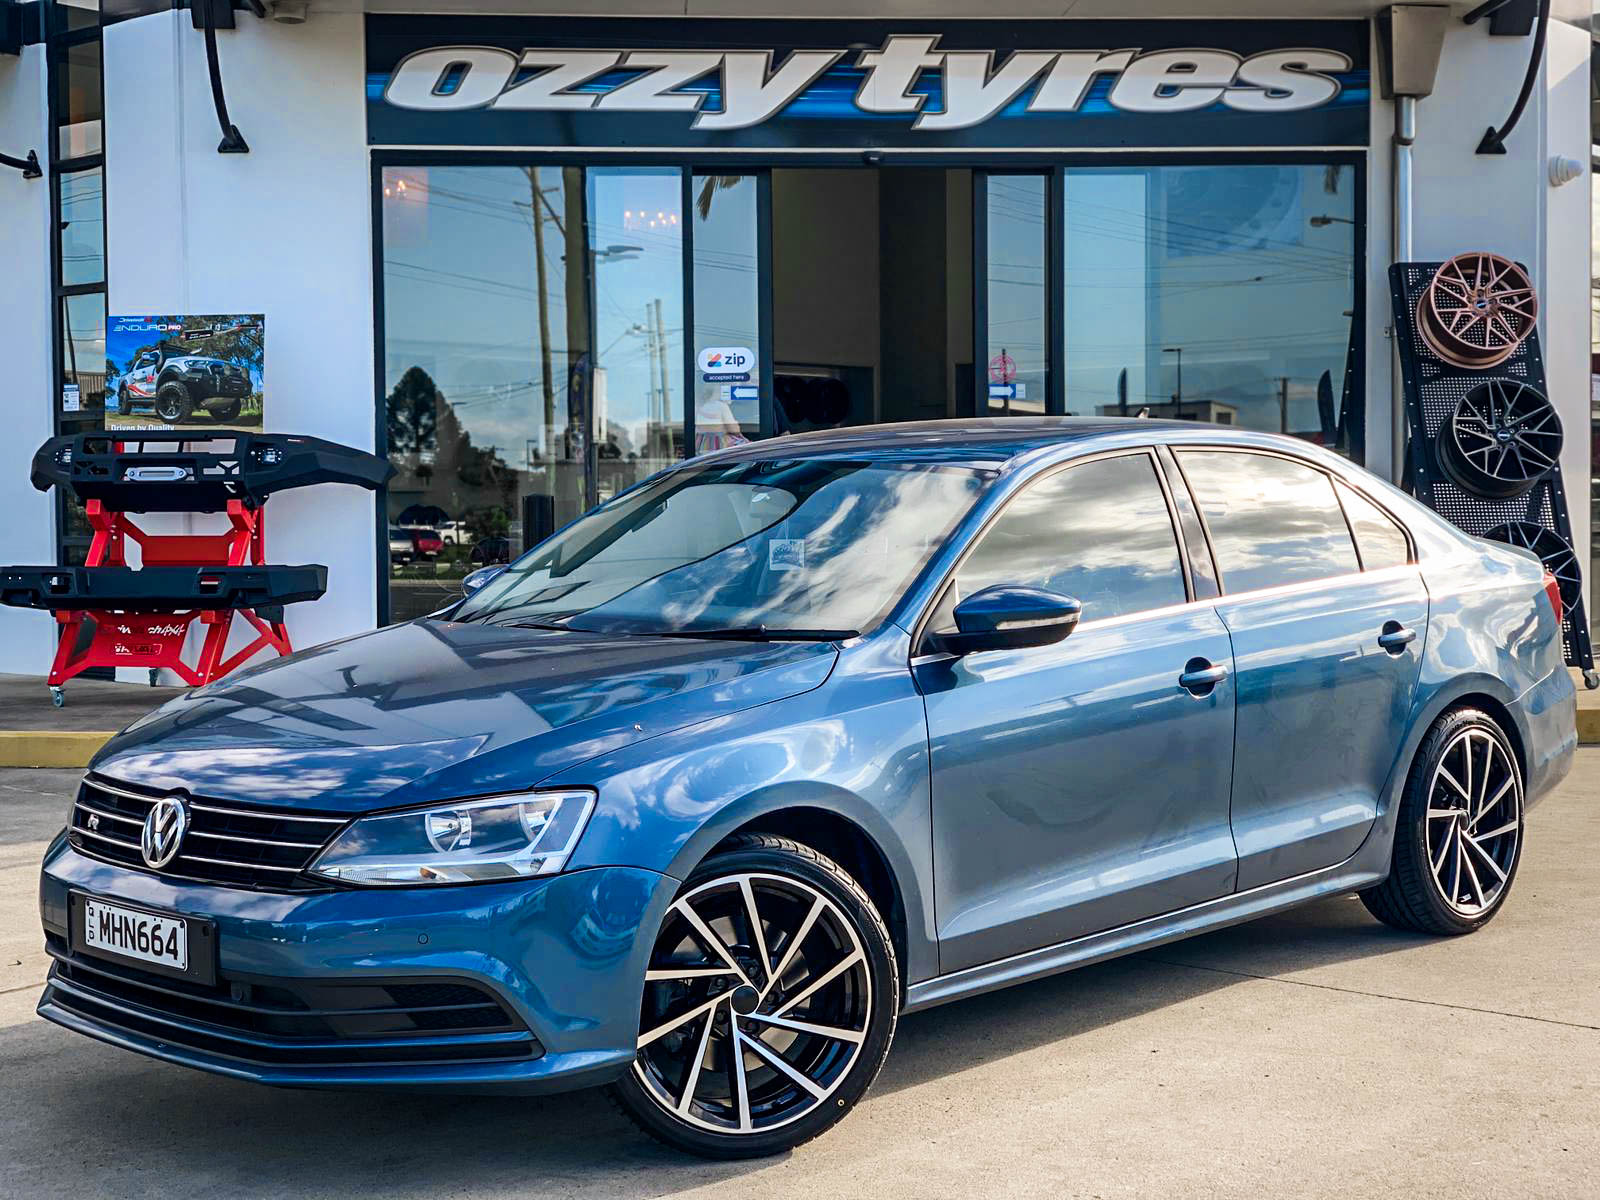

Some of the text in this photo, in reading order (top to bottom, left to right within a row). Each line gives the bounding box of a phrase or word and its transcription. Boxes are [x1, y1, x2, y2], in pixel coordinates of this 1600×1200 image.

[384, 33, 1353, 131] ozzy tyres
[725, 353, 746, 367] zip
[99, 909, 179, 960] MHN664
